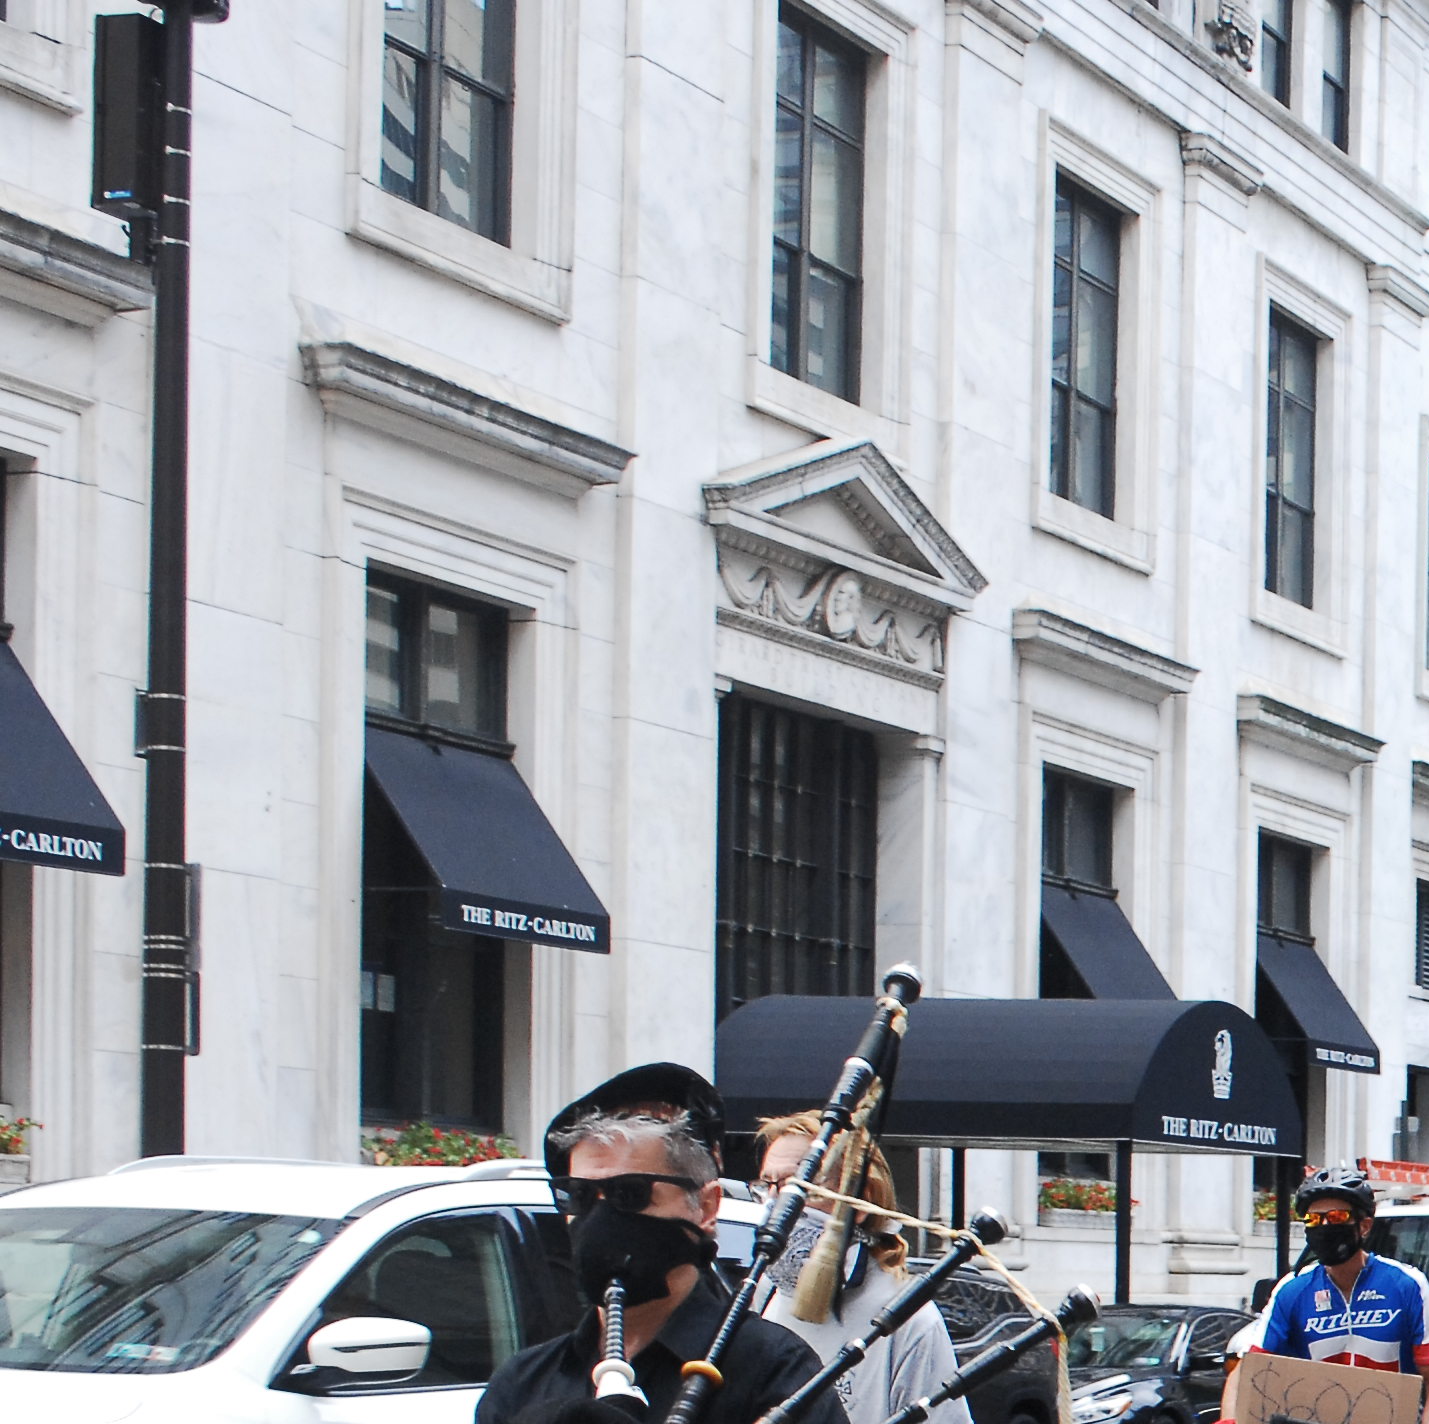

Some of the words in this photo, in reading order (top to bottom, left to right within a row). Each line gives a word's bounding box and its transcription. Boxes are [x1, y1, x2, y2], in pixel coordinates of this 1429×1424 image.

[0, 829, 103, 861] -CARLTON
[461, 904, 491, 925] THE
[494, 909, 596, 942] RITZ-CARLTON
[1161, 1115, 1188, 1137] THE
[1190, 1118, 1277, 1145] RITZ-CARLTON
[1304, 1308, 1402, 1334] RITCHEY
